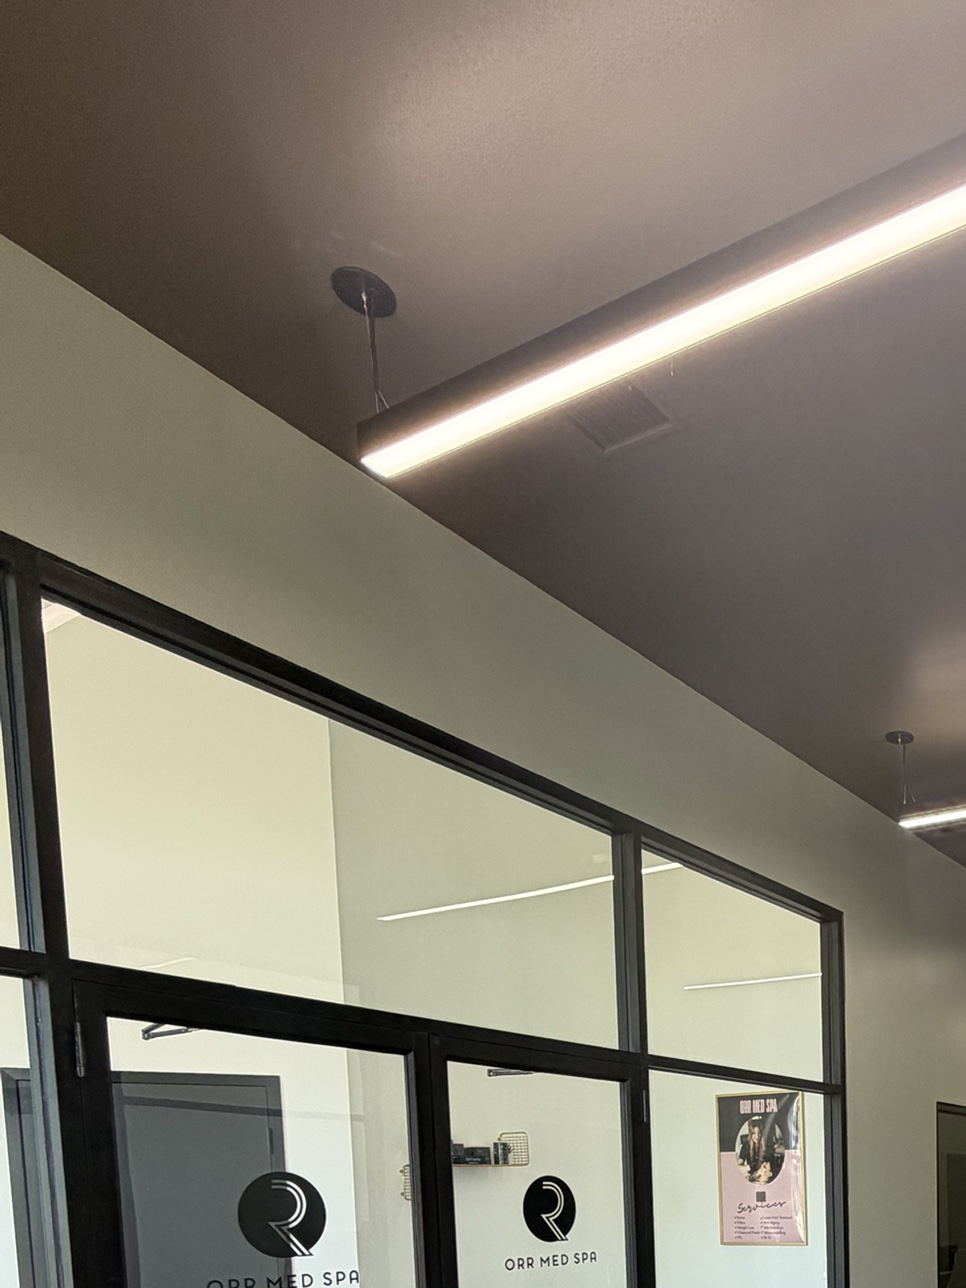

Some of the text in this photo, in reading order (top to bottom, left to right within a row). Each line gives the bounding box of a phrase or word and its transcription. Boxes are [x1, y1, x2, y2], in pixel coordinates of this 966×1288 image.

[752, 1099, 765, 1113] MED
[766, 1098, 778, 1113] SPA
[737, 1201, 787, 1213] Services
[504, 1251, 597, 1271] ORR MED SPA
[322, 1269, 360, 1286] SPA
